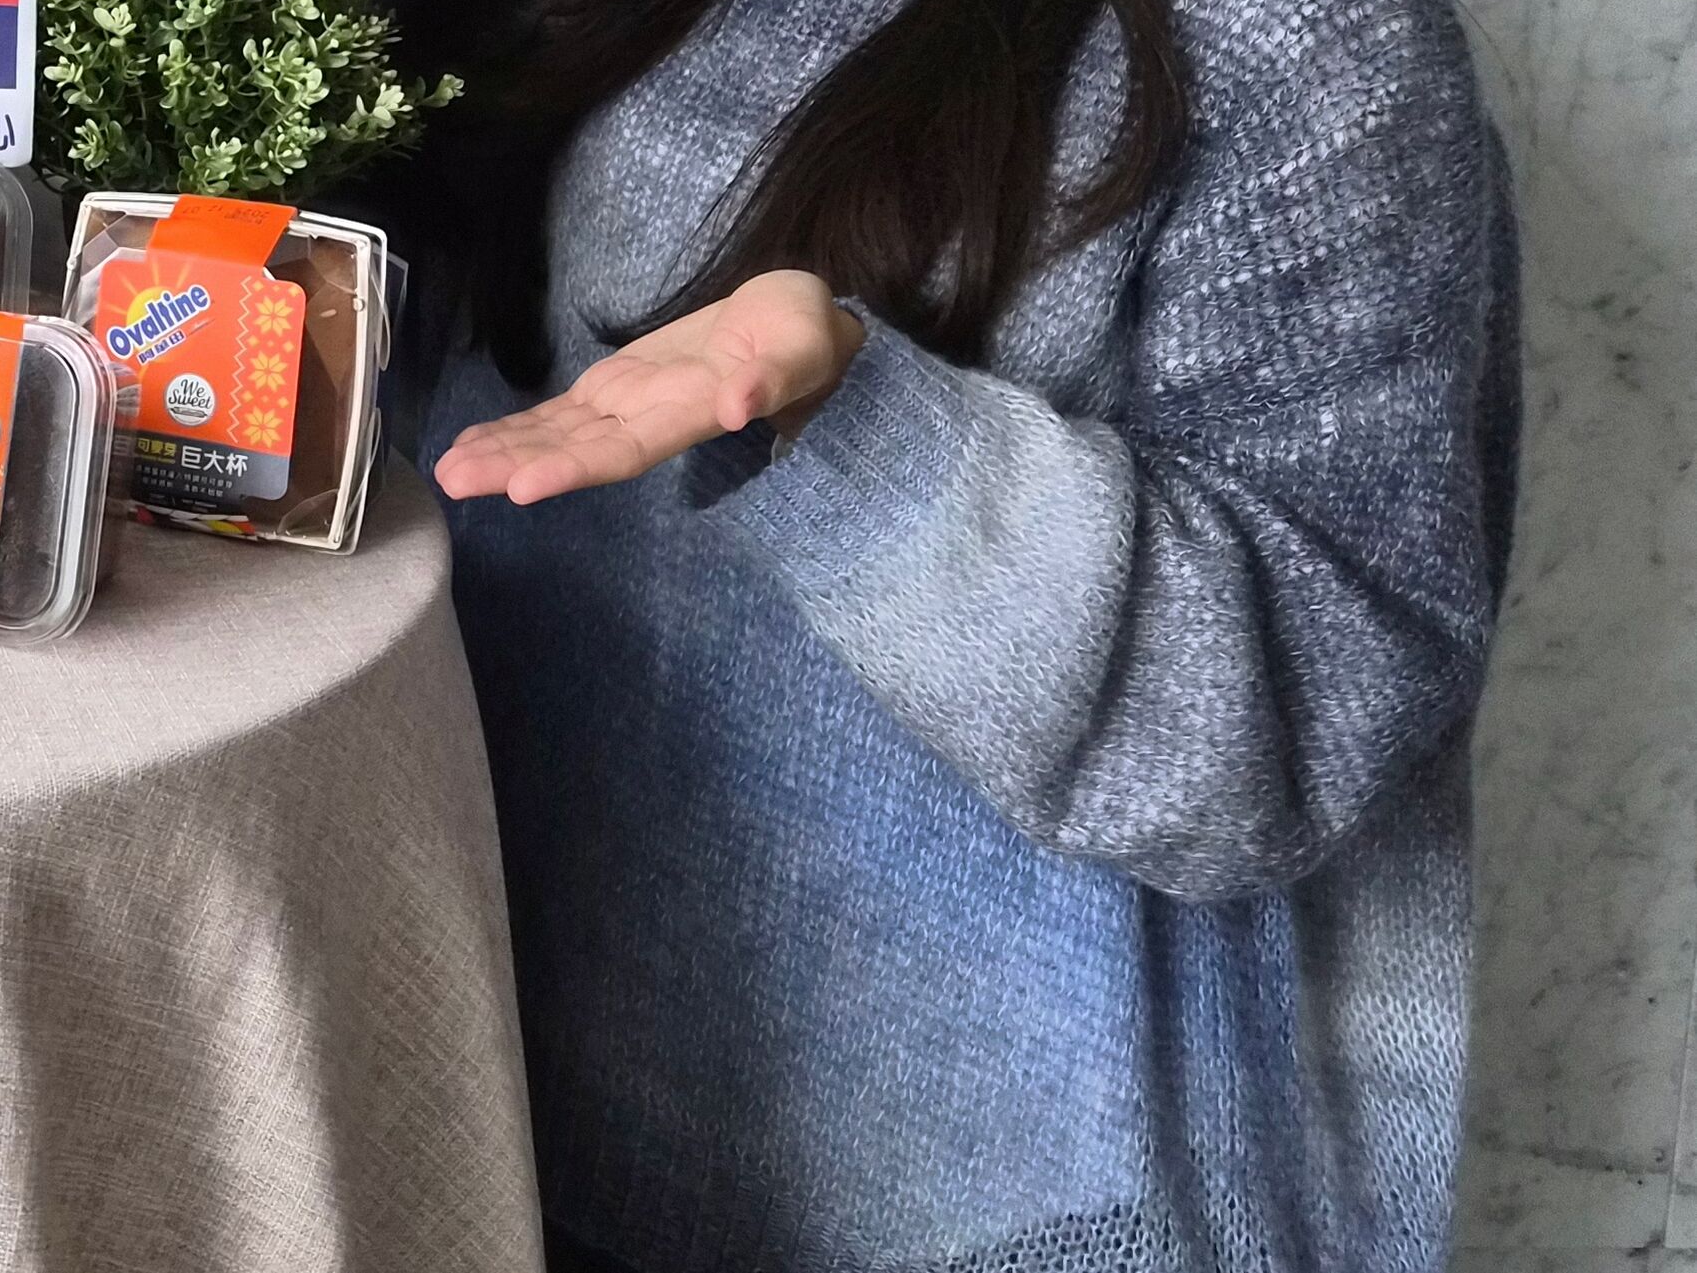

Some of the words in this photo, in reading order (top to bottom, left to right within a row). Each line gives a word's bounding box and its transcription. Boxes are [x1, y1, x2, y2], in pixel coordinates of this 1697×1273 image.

[109, 286, 209, 357] Ovaltine
[168, 388, 213, 410] Sweet
[180, 378, 206, 398] We
[180, 444, 249, 478] 巨大杯
